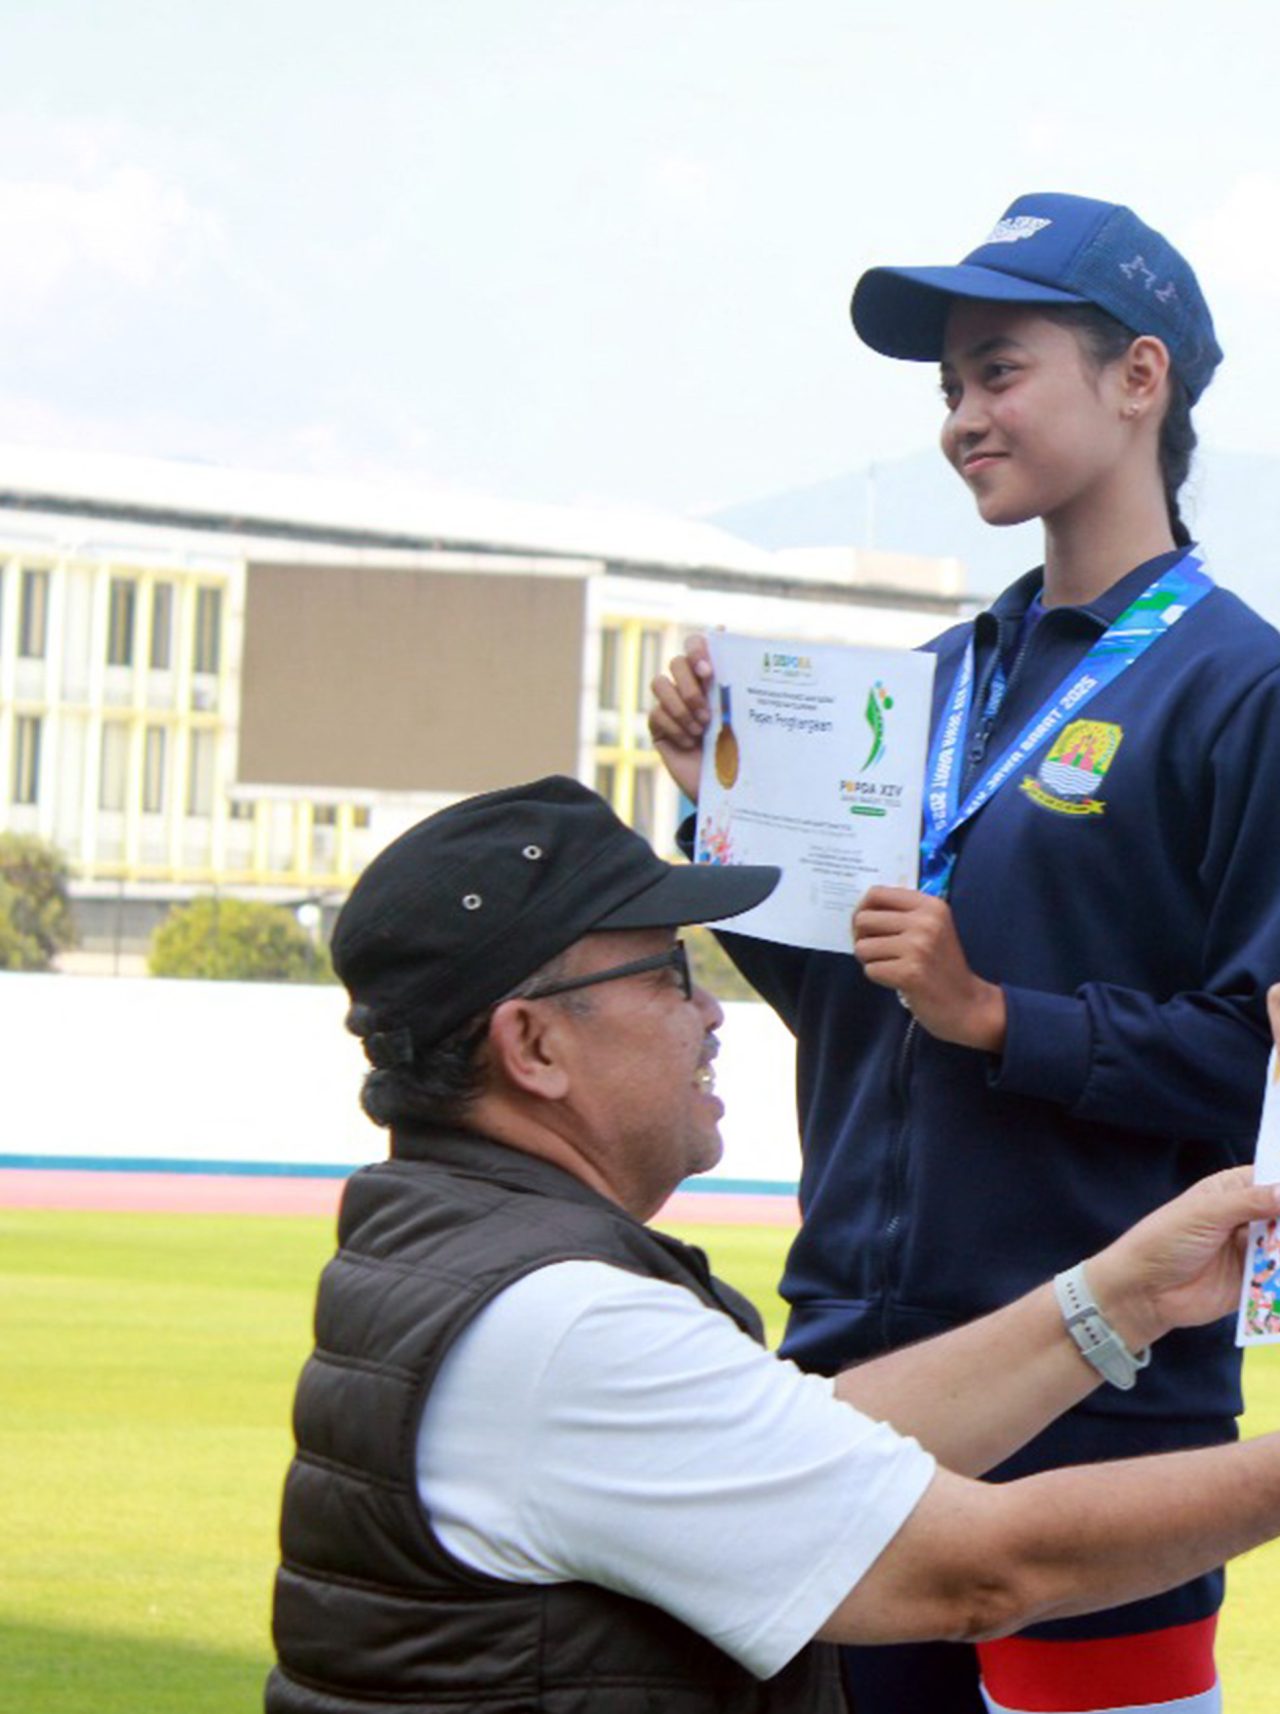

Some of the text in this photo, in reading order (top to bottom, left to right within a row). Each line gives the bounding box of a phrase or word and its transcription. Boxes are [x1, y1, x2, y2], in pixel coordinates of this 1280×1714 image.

[986, 750, 1024, 791] JAWA
[1020, 707, 1062, 752] BARAT
[1059, 674, 1098, 711] 2025
